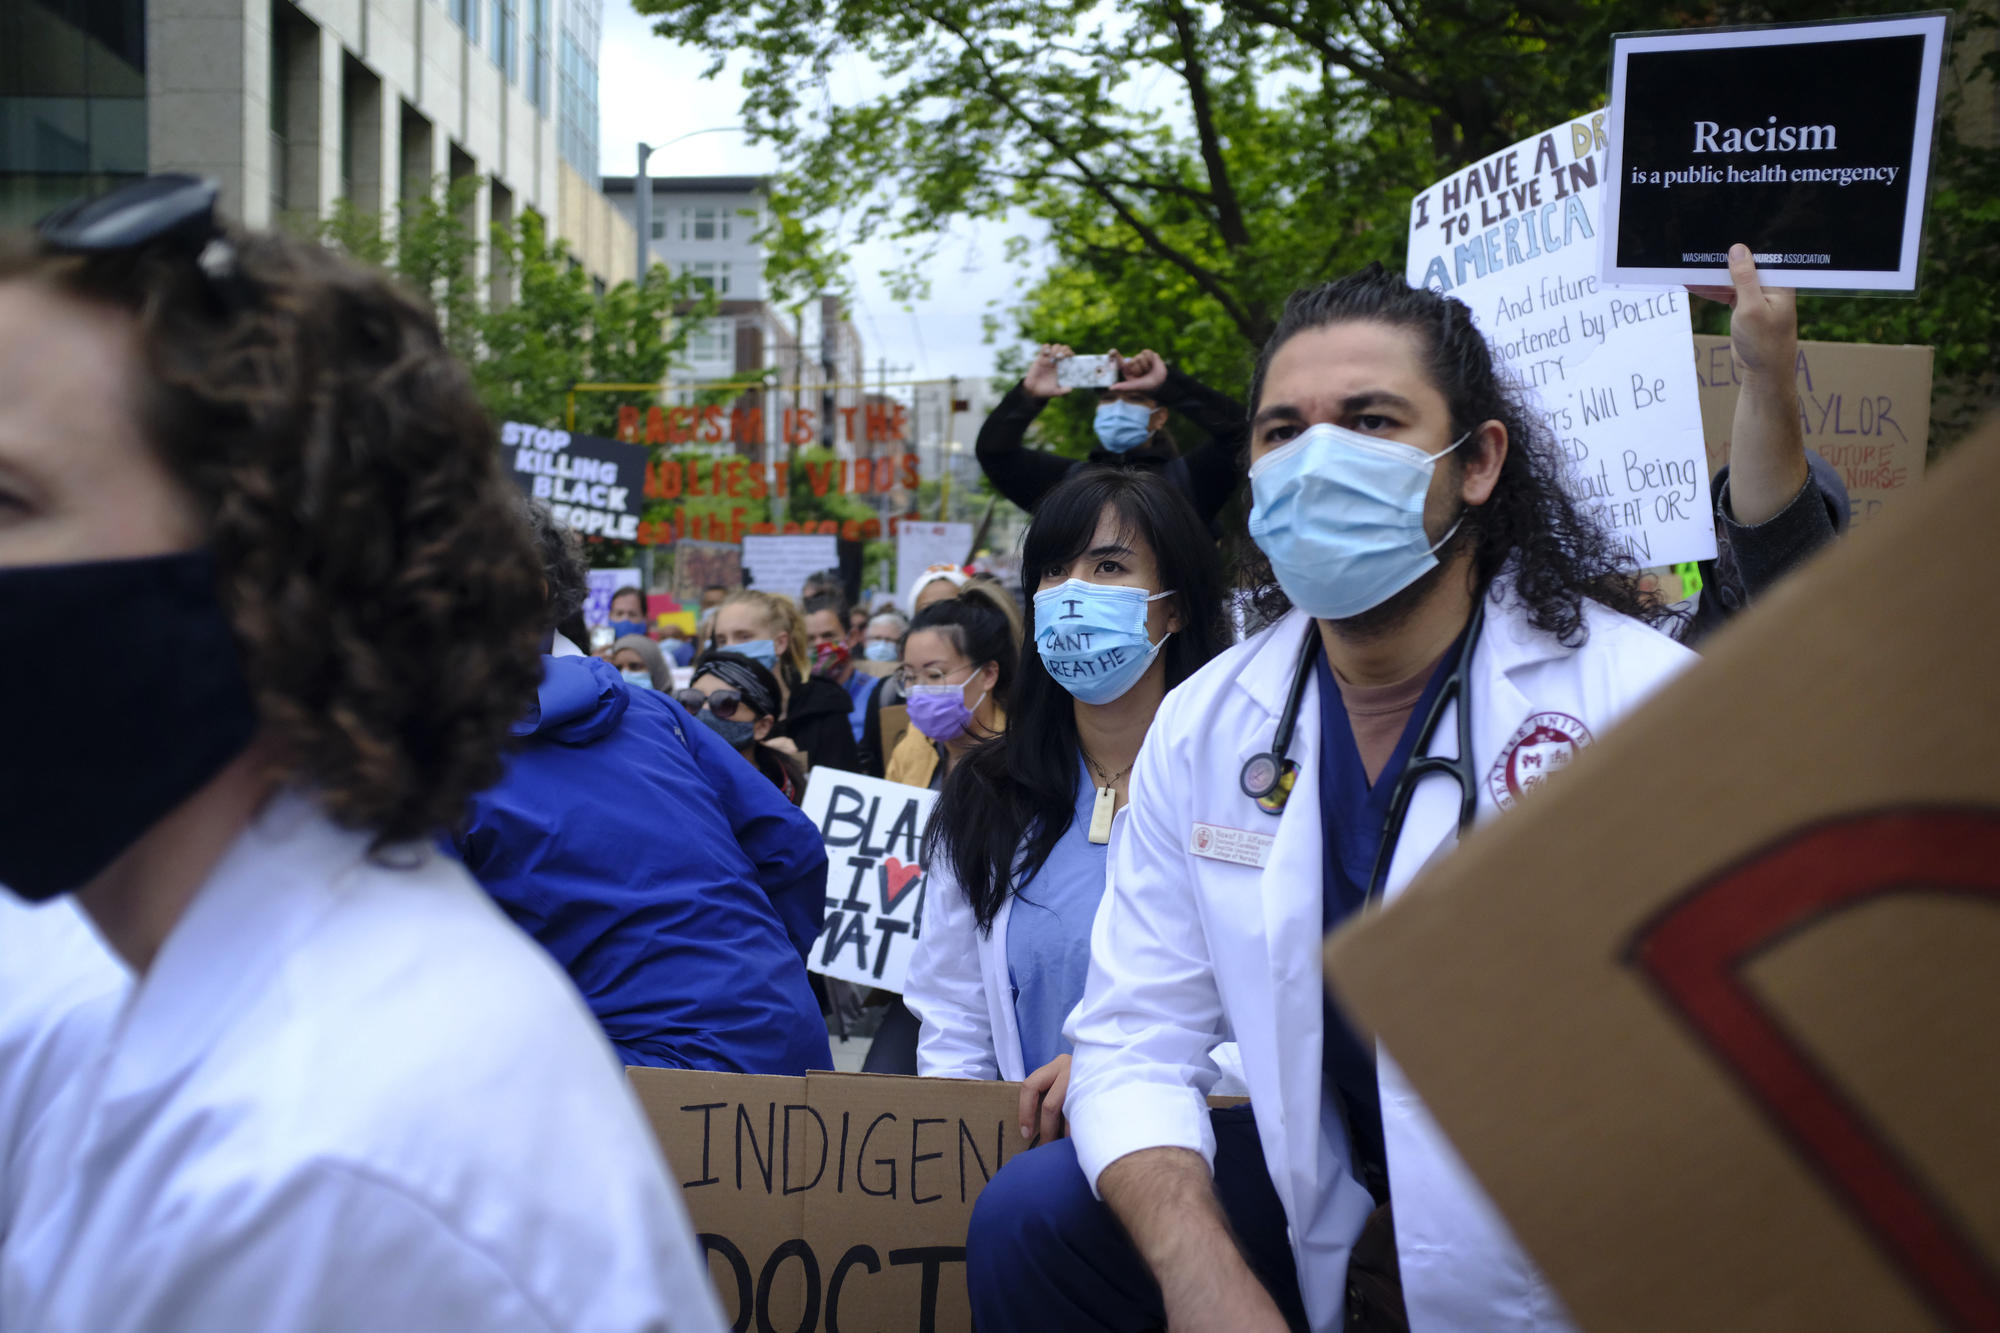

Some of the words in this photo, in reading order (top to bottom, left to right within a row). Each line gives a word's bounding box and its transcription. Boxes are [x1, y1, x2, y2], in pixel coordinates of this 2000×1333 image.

[1693, 116, 1837, 153] Racism
[1415, 195, 1431, 231] I
[1443, 150, 1519, 216] HAVE
[1535, 133, 1560, 175] A
[1631, 167, 1647, 184] is
[1650, 170, 1660, 184] a
[1663, 166, 1723, 188] public
[1727, 164, 1787, 183] health
[1791, 166, 1900, 186] emergency
[1441, 212, 1470, 245] TO
[1482, 177, 1541, 228] LIVE
[1552, 155, 1598, 200] IN
[1421, 194, 1595, 293] AMERICA
[1783, 253, 1830, 264] ASSOCIATION
[1496, 286, 1534, 327] And
[1540, 275, 1598, 310] future
[1487, 315, 1571, 363] hortened
[1580, 310, 1605, 344] by
[1611, 291, 1679, 328] POLICE
[1580, 386, 1619, 427] Will
[1631, 373, 1666, 410] Be
[1798, 392, 1909, 443] AYLOR
[500, 421, 571, 454] STOP
[617, 405, 765, 445] RACISM
[783, 408, 814, 445] IS
[839, 402, 909, 442] THE
[514, 449, 619, 485] KILLING
[1623, 449, 1697, 502] Being
[1819, 442, 1895, 472] FUTURE
[1846, 462, 1908, 489] NURSE
[532, 475, 629, 512] BLACK
[643, 460, 790, 499] ADLIEST
[804, 453, 921, 498] VIRUS
[551, 503, 640, 540] EOPLE
[1655, 490, 1690, 523] OR
[1059, 599, 1084, 620] I
